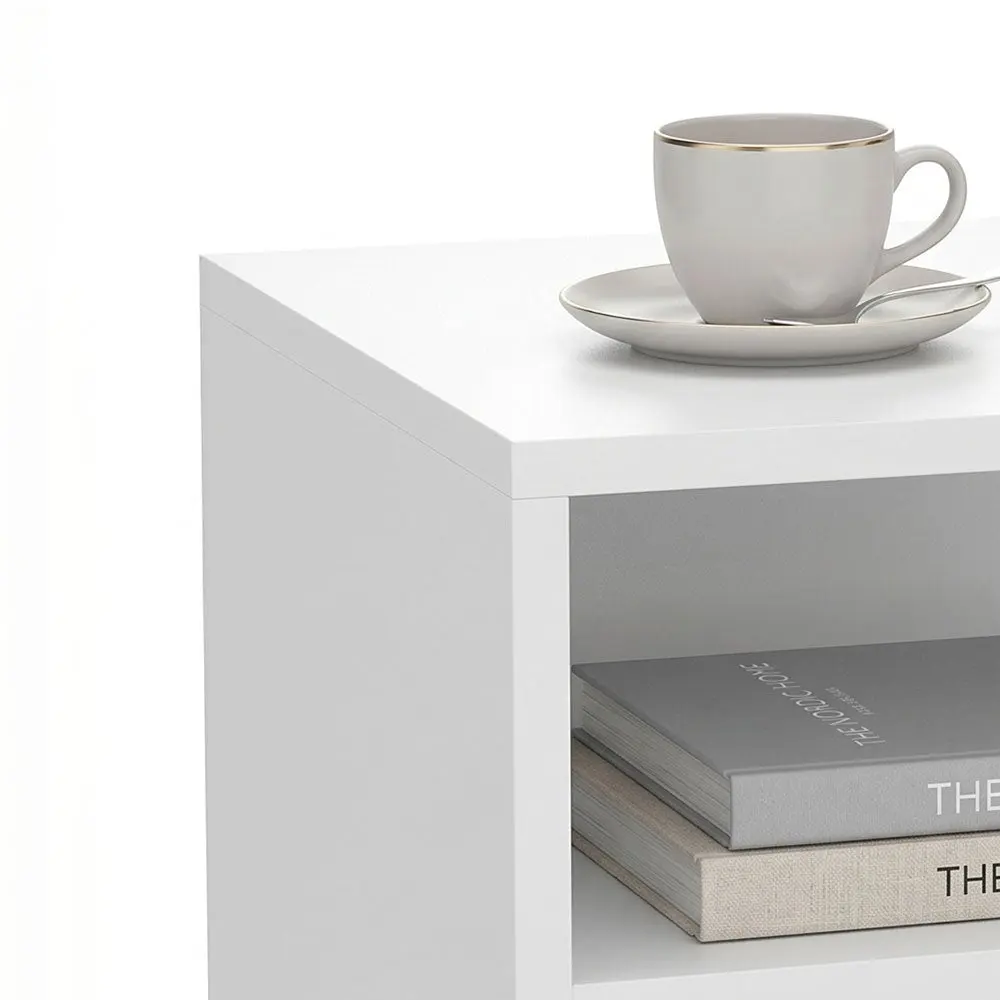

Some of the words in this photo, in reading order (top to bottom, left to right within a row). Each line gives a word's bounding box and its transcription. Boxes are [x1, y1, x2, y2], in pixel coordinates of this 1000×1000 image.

[739, 662, 801, 690] HOME
[782, 689, 859, 726] NORDIC
[837, 725, 886, 747] THE
